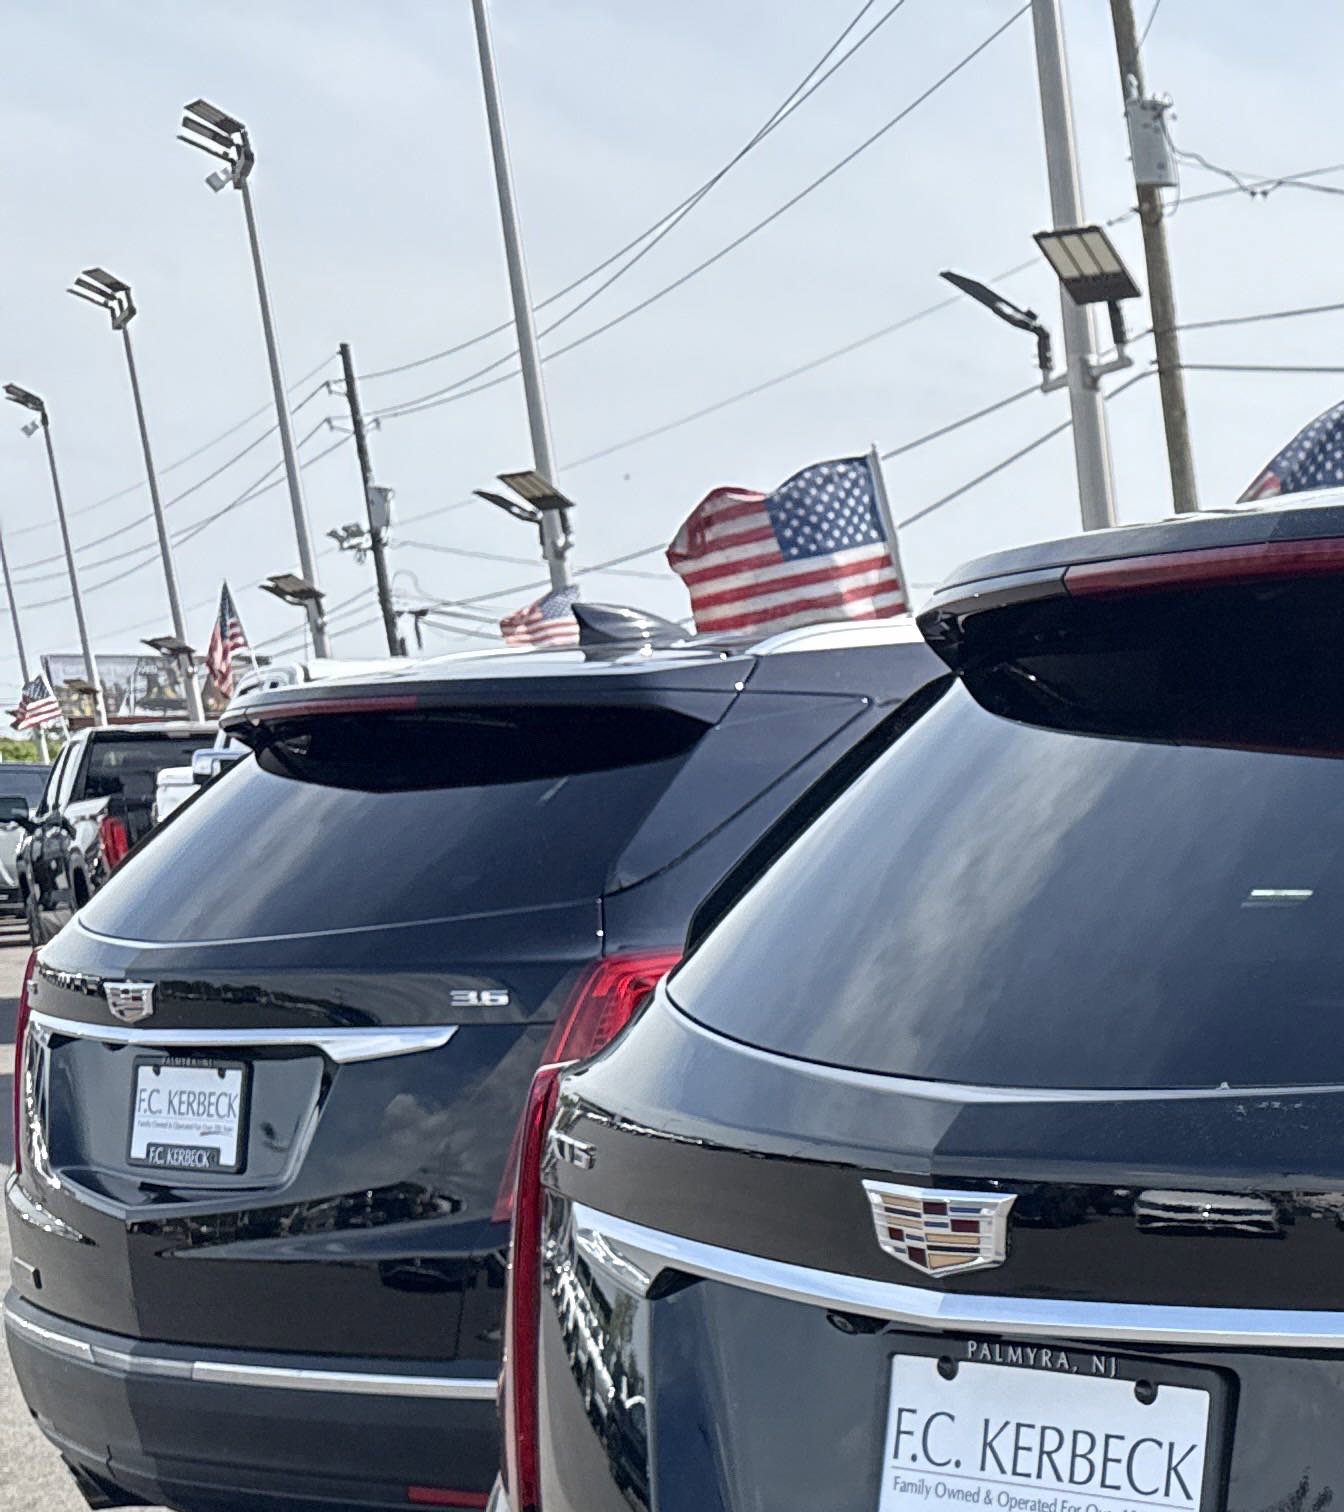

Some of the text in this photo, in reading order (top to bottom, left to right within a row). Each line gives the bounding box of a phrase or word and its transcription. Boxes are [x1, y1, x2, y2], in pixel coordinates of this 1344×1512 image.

[138, 1088, 238, 1118] F.C. KERBECK
[166, 1147, 210, 1168] KERBECK
[966, 1340, 1118, 1377] PALMYRA, NJ
[893, 1407, 1198, 1500] F.C. KERBECK
[893, 1476, 931, 1500] Family
[935, 1482, 980, 1504] Owned
[984, 1489, 993, 1505] &
